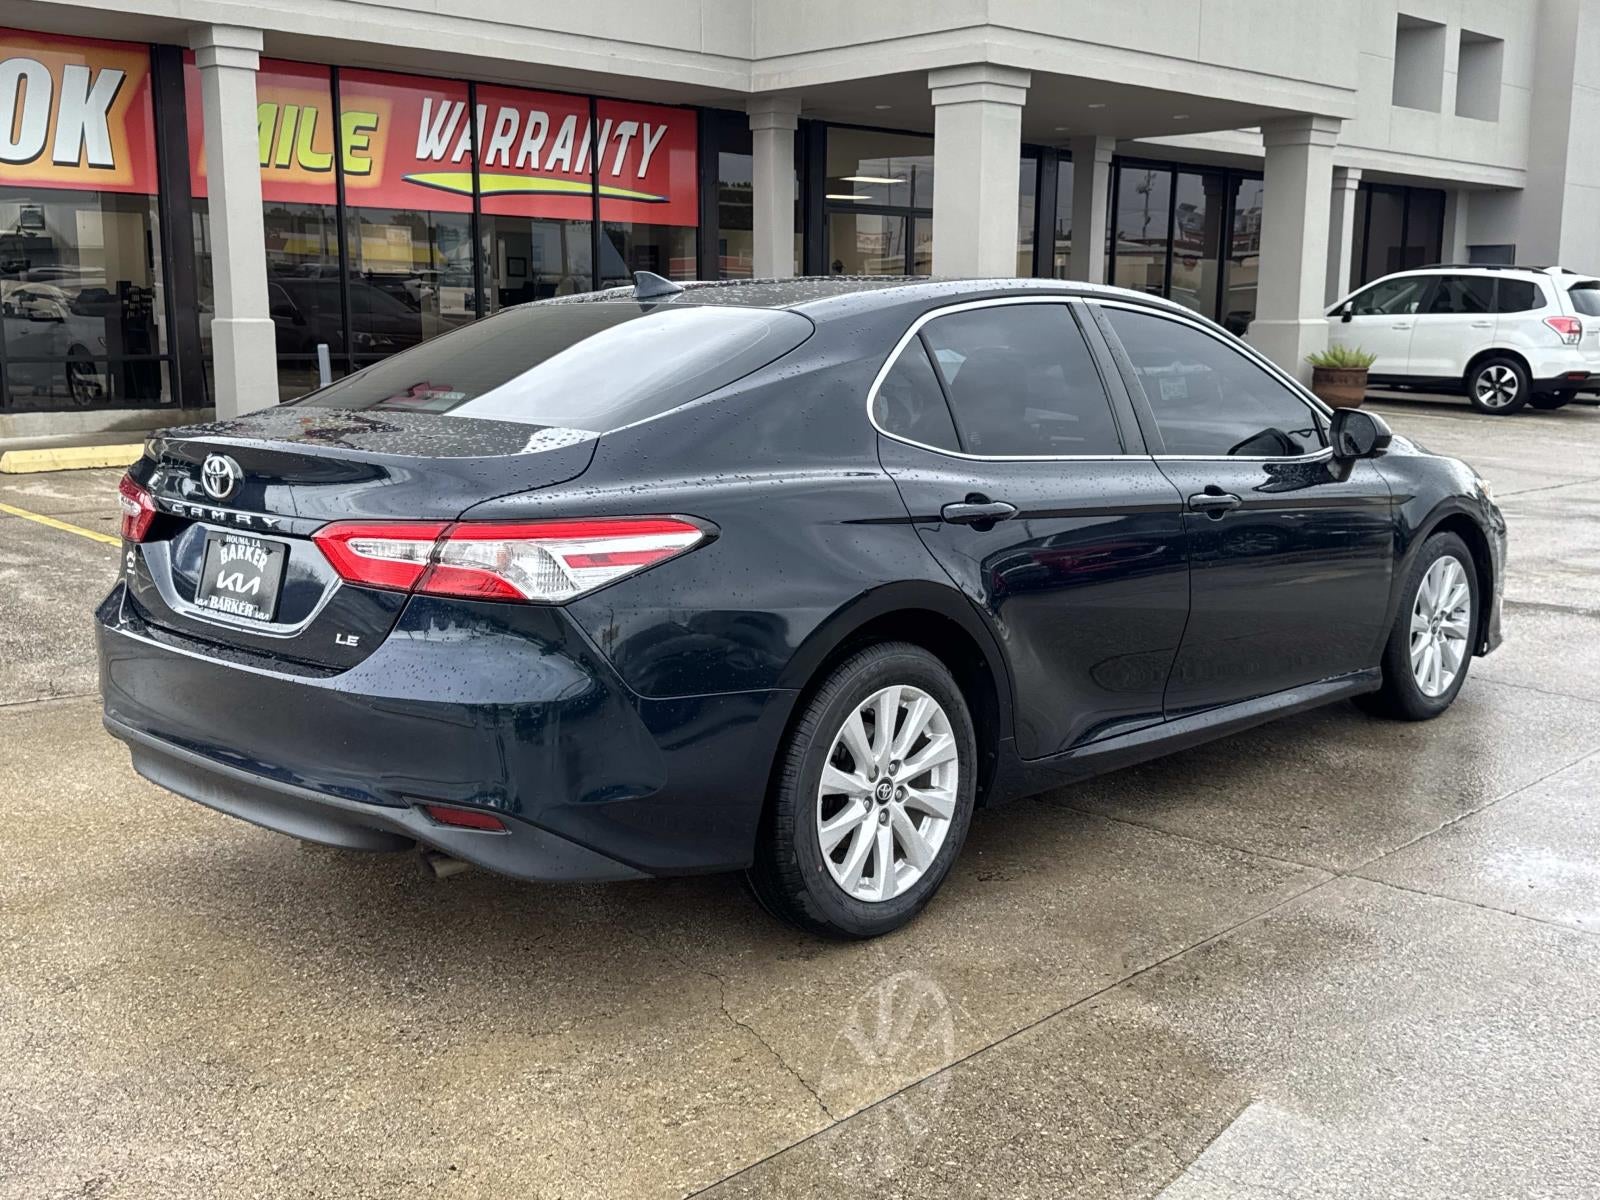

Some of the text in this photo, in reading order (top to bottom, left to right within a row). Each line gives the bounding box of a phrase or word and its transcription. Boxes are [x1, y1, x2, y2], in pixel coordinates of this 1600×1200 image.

[416, 97, 668, 178] WARRANTY
[172, 503, 280, 528] CAMRY
[251, 538, 261, 548] LA
[220, 544, 268, 572] BARKER
[209, 595, 255, 617] BARKER
[335, 633, 360, 647] LE
